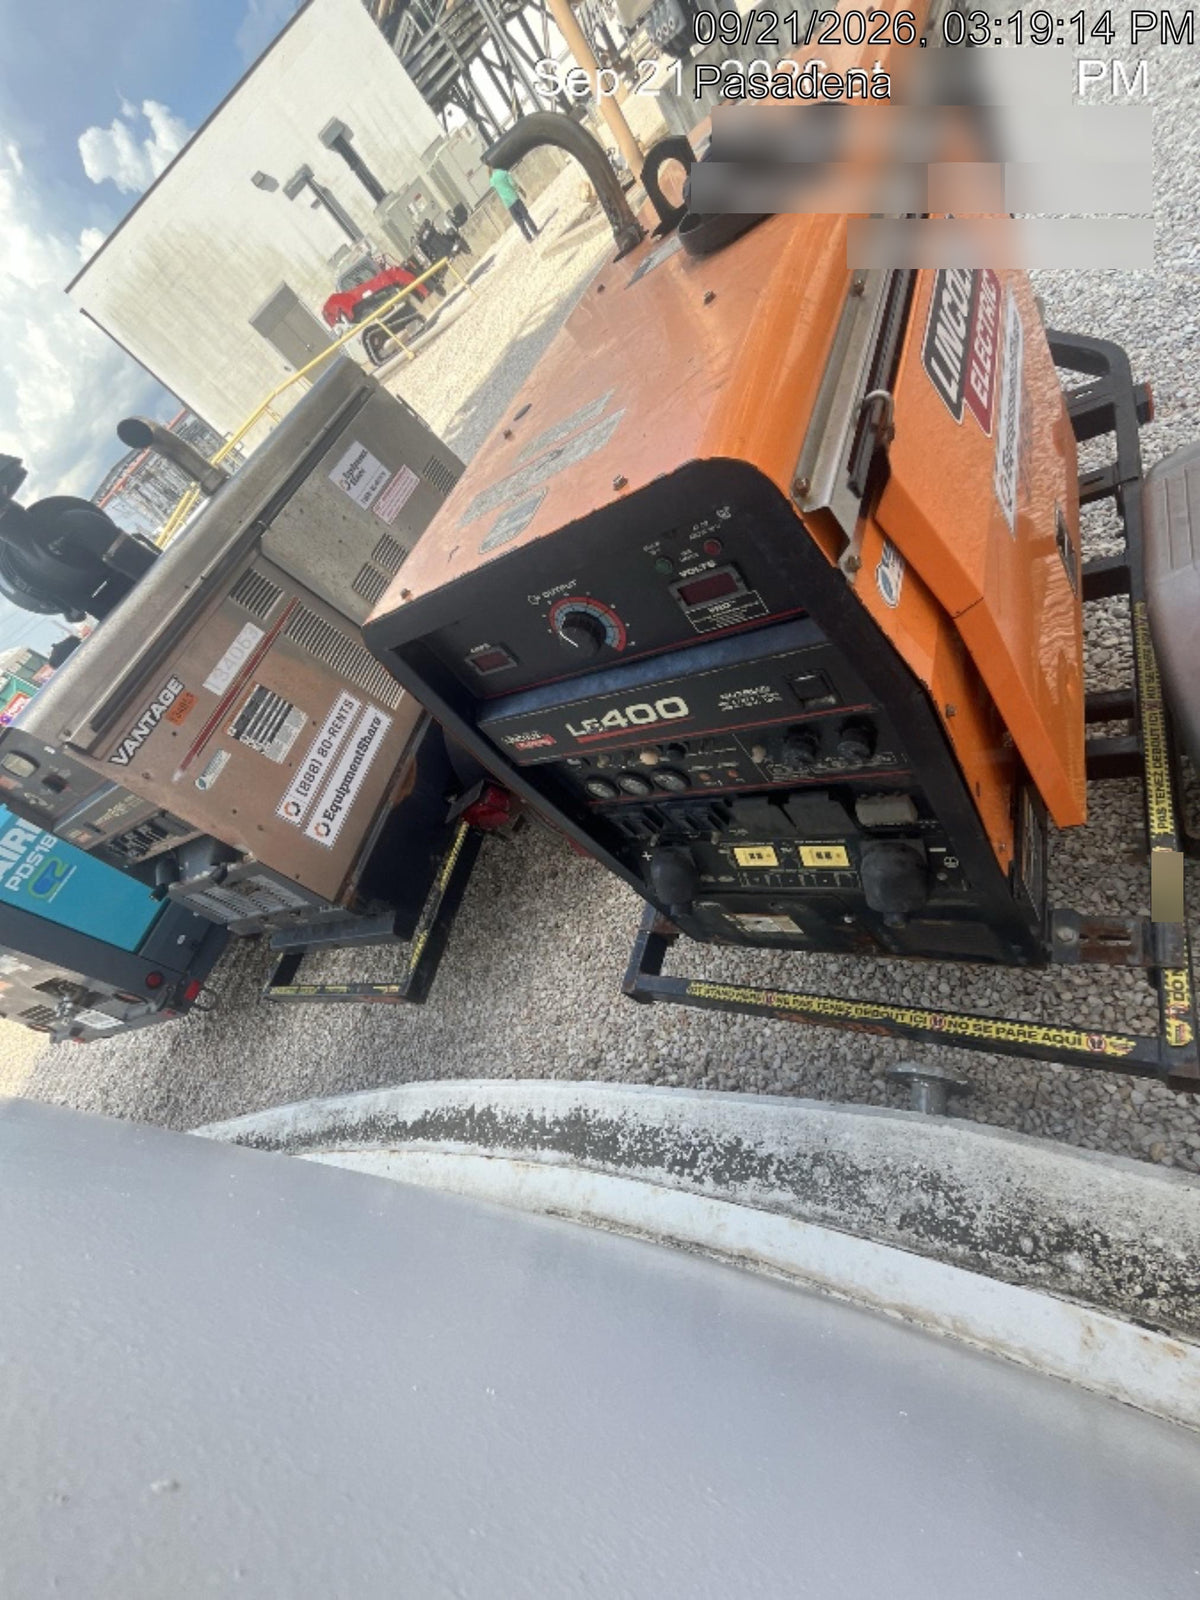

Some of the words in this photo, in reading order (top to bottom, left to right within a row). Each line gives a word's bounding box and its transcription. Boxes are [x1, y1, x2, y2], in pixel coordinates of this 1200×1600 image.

[931, 269, 975, 404] LINCOL
[109, 675, 184, 766] VANTAGE
[296, 758, 323, 798] (888)
[317, 699, 354, 758] 80-RENTS
[323, 716, 382, 822] EquipmentShare
[947, 1018, 969, 1030] NO
[995, 1027, 1038, 1041] PARE
[1042, 1033, 1082, 1047] AQUI
